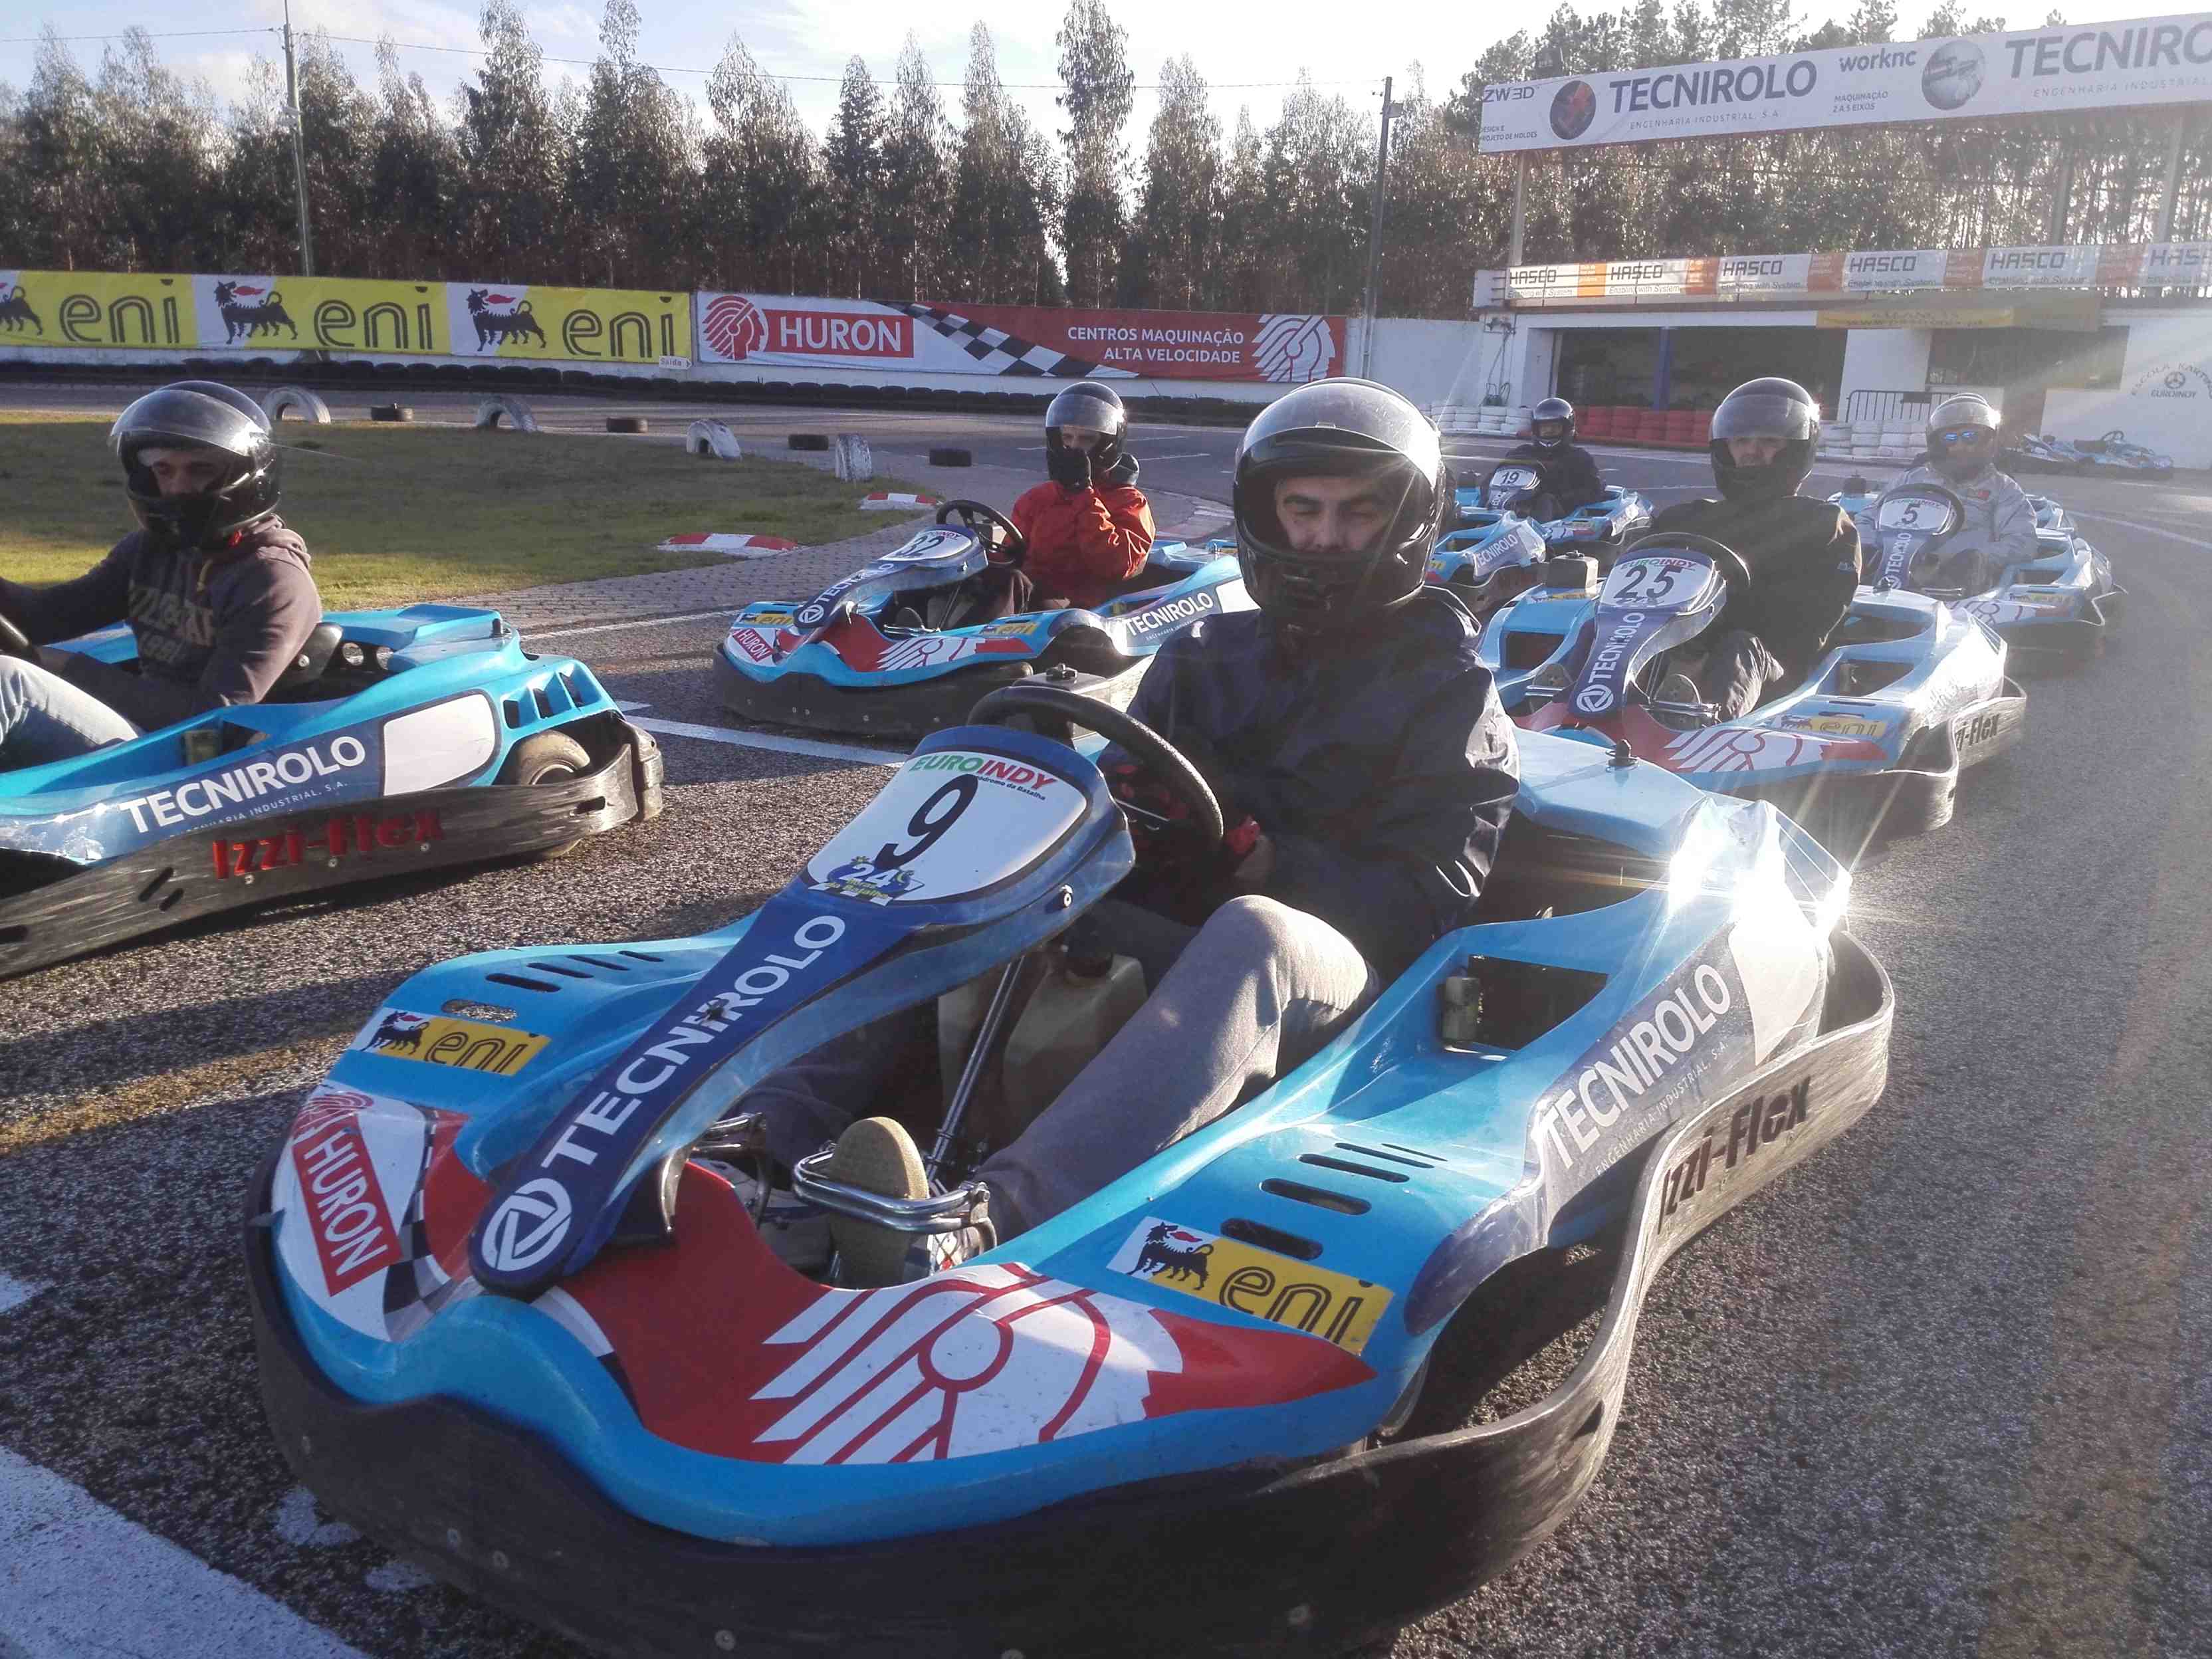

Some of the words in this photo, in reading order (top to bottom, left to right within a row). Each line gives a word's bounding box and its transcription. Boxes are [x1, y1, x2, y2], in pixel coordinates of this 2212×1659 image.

[1838, 48, 1918, 72] worknc
[1609, 60, 1817, 113] TECNIROLO
[1834, 90, 1888, 102] MAQUINAÇÃO
[1852, 102, 1876, 112] EIXOS
[1630, 117, 1692, 129] ENGENHARIA
[1611, 265, 1664, 280] HASCO
[1723, 260, 1783, 276] HASCO
[1850, 256, 1917, 272] HASCO
[1991, 252, 2066, 270] HASCO
[1510, 269, 1557, 284] HASCO
[1654, 285, 1680, 294] System
[59, 278, 179, 344] eni
[314, 286, 433, 350] eni
[562, 296, 673, 358] eni
[780, 316, 901, 351] HURON
[1067, 326, 1137, 341] CENTROS
[1141, 328, 1244, 346] MAQUINAÇÃO
[1103, 347, 1143, 360] ALTA
[1147, 348, 1240, 363] VELOCIDADE
[1501, 472, 1519, 484] 19
[1902, 504, 1921, 524] 5
[896, 536, 944, 556] 32
[1621, 558, 1696, 570] EUROINDY
[1614, 565, 1684, 598] 25
[1125, 592, 1214, 635] TECNIROLO
[738, 629, 770, 658] HURON
[1820, 720, 1880, 736] eni
[117, 736, 366, 833] TECNIROLO
[909, 755, 1057, 790] EUROINDY
[1017, 786, 1046, 801] Batalha
[875, 774, 978, 869] 9
[839, 863, 899, 887] 24
[425, 1030, 537, 1075] eni
[542, 915, 845, 1166] TECNIROLO
[1537, 964, 1731, 1170] TECNIROLO
[1596, 1112, 1656, 1176] ENGENHARIA
[304, 1129, 388, 1276] HURON
[1219, 1266, 1374, 1344] eni
